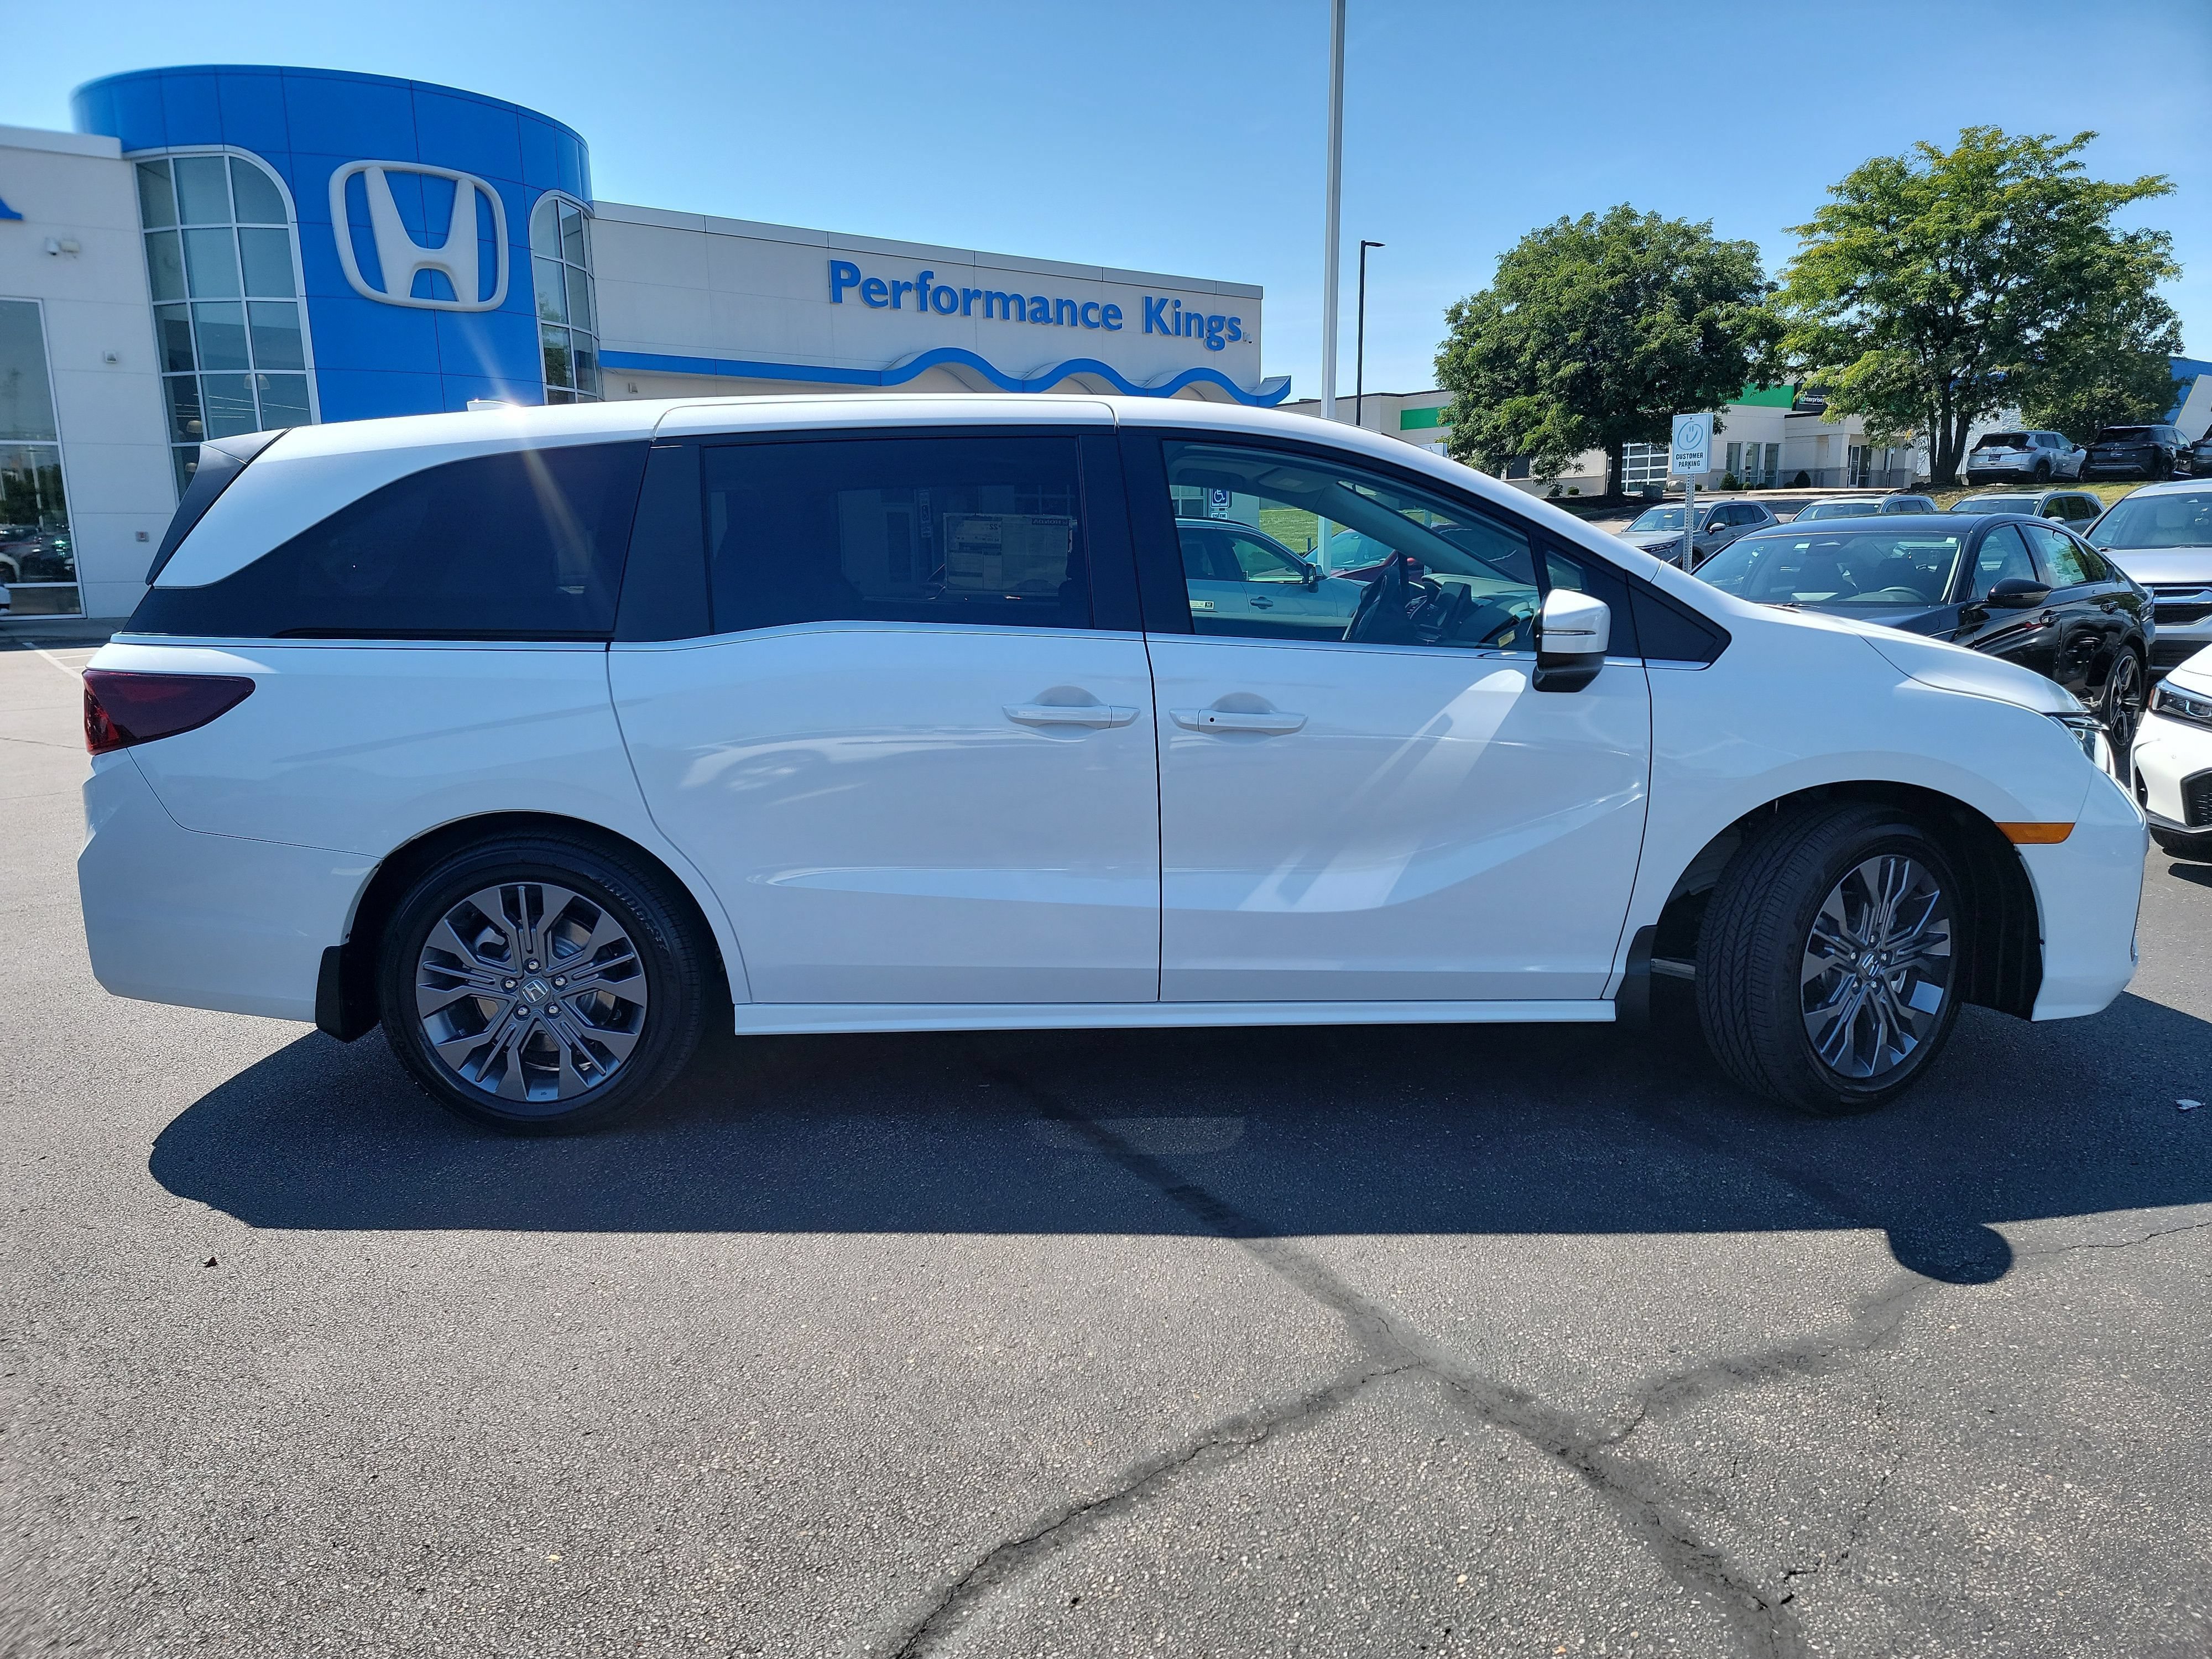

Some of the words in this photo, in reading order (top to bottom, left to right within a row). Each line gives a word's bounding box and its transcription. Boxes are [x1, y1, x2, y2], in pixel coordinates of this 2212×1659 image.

[827, 259, 1123, 331] Performance
[1142, 296, 1243, 351] Kings
[1676, 452, 1703, 460] CUSTOMER
